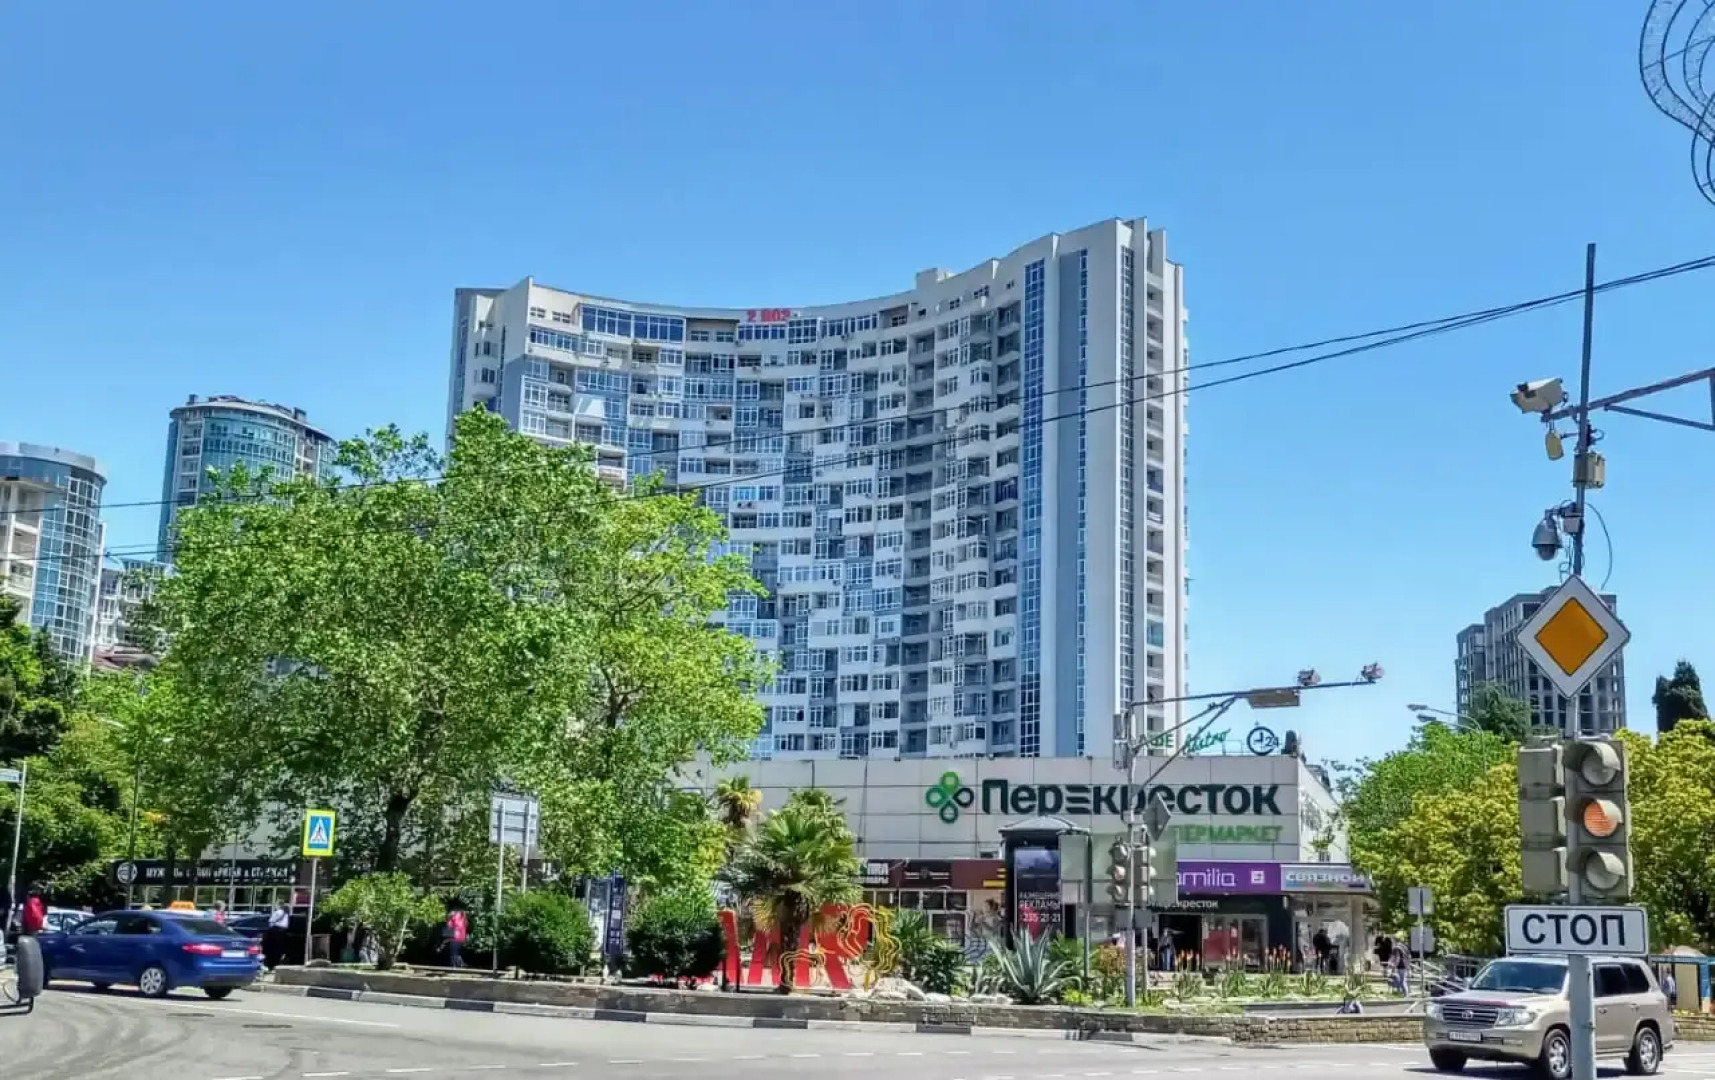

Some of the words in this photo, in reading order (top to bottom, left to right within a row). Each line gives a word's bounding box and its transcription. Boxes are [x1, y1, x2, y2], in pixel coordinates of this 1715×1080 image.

[982, 779, 1282, 815] Перекресток
[1169, 825, 1282, 841] ПЕРМАРКЕТ
[1176, 868, 1237, 886] amilia
[1522, 914, 1626, 946] СТОП
